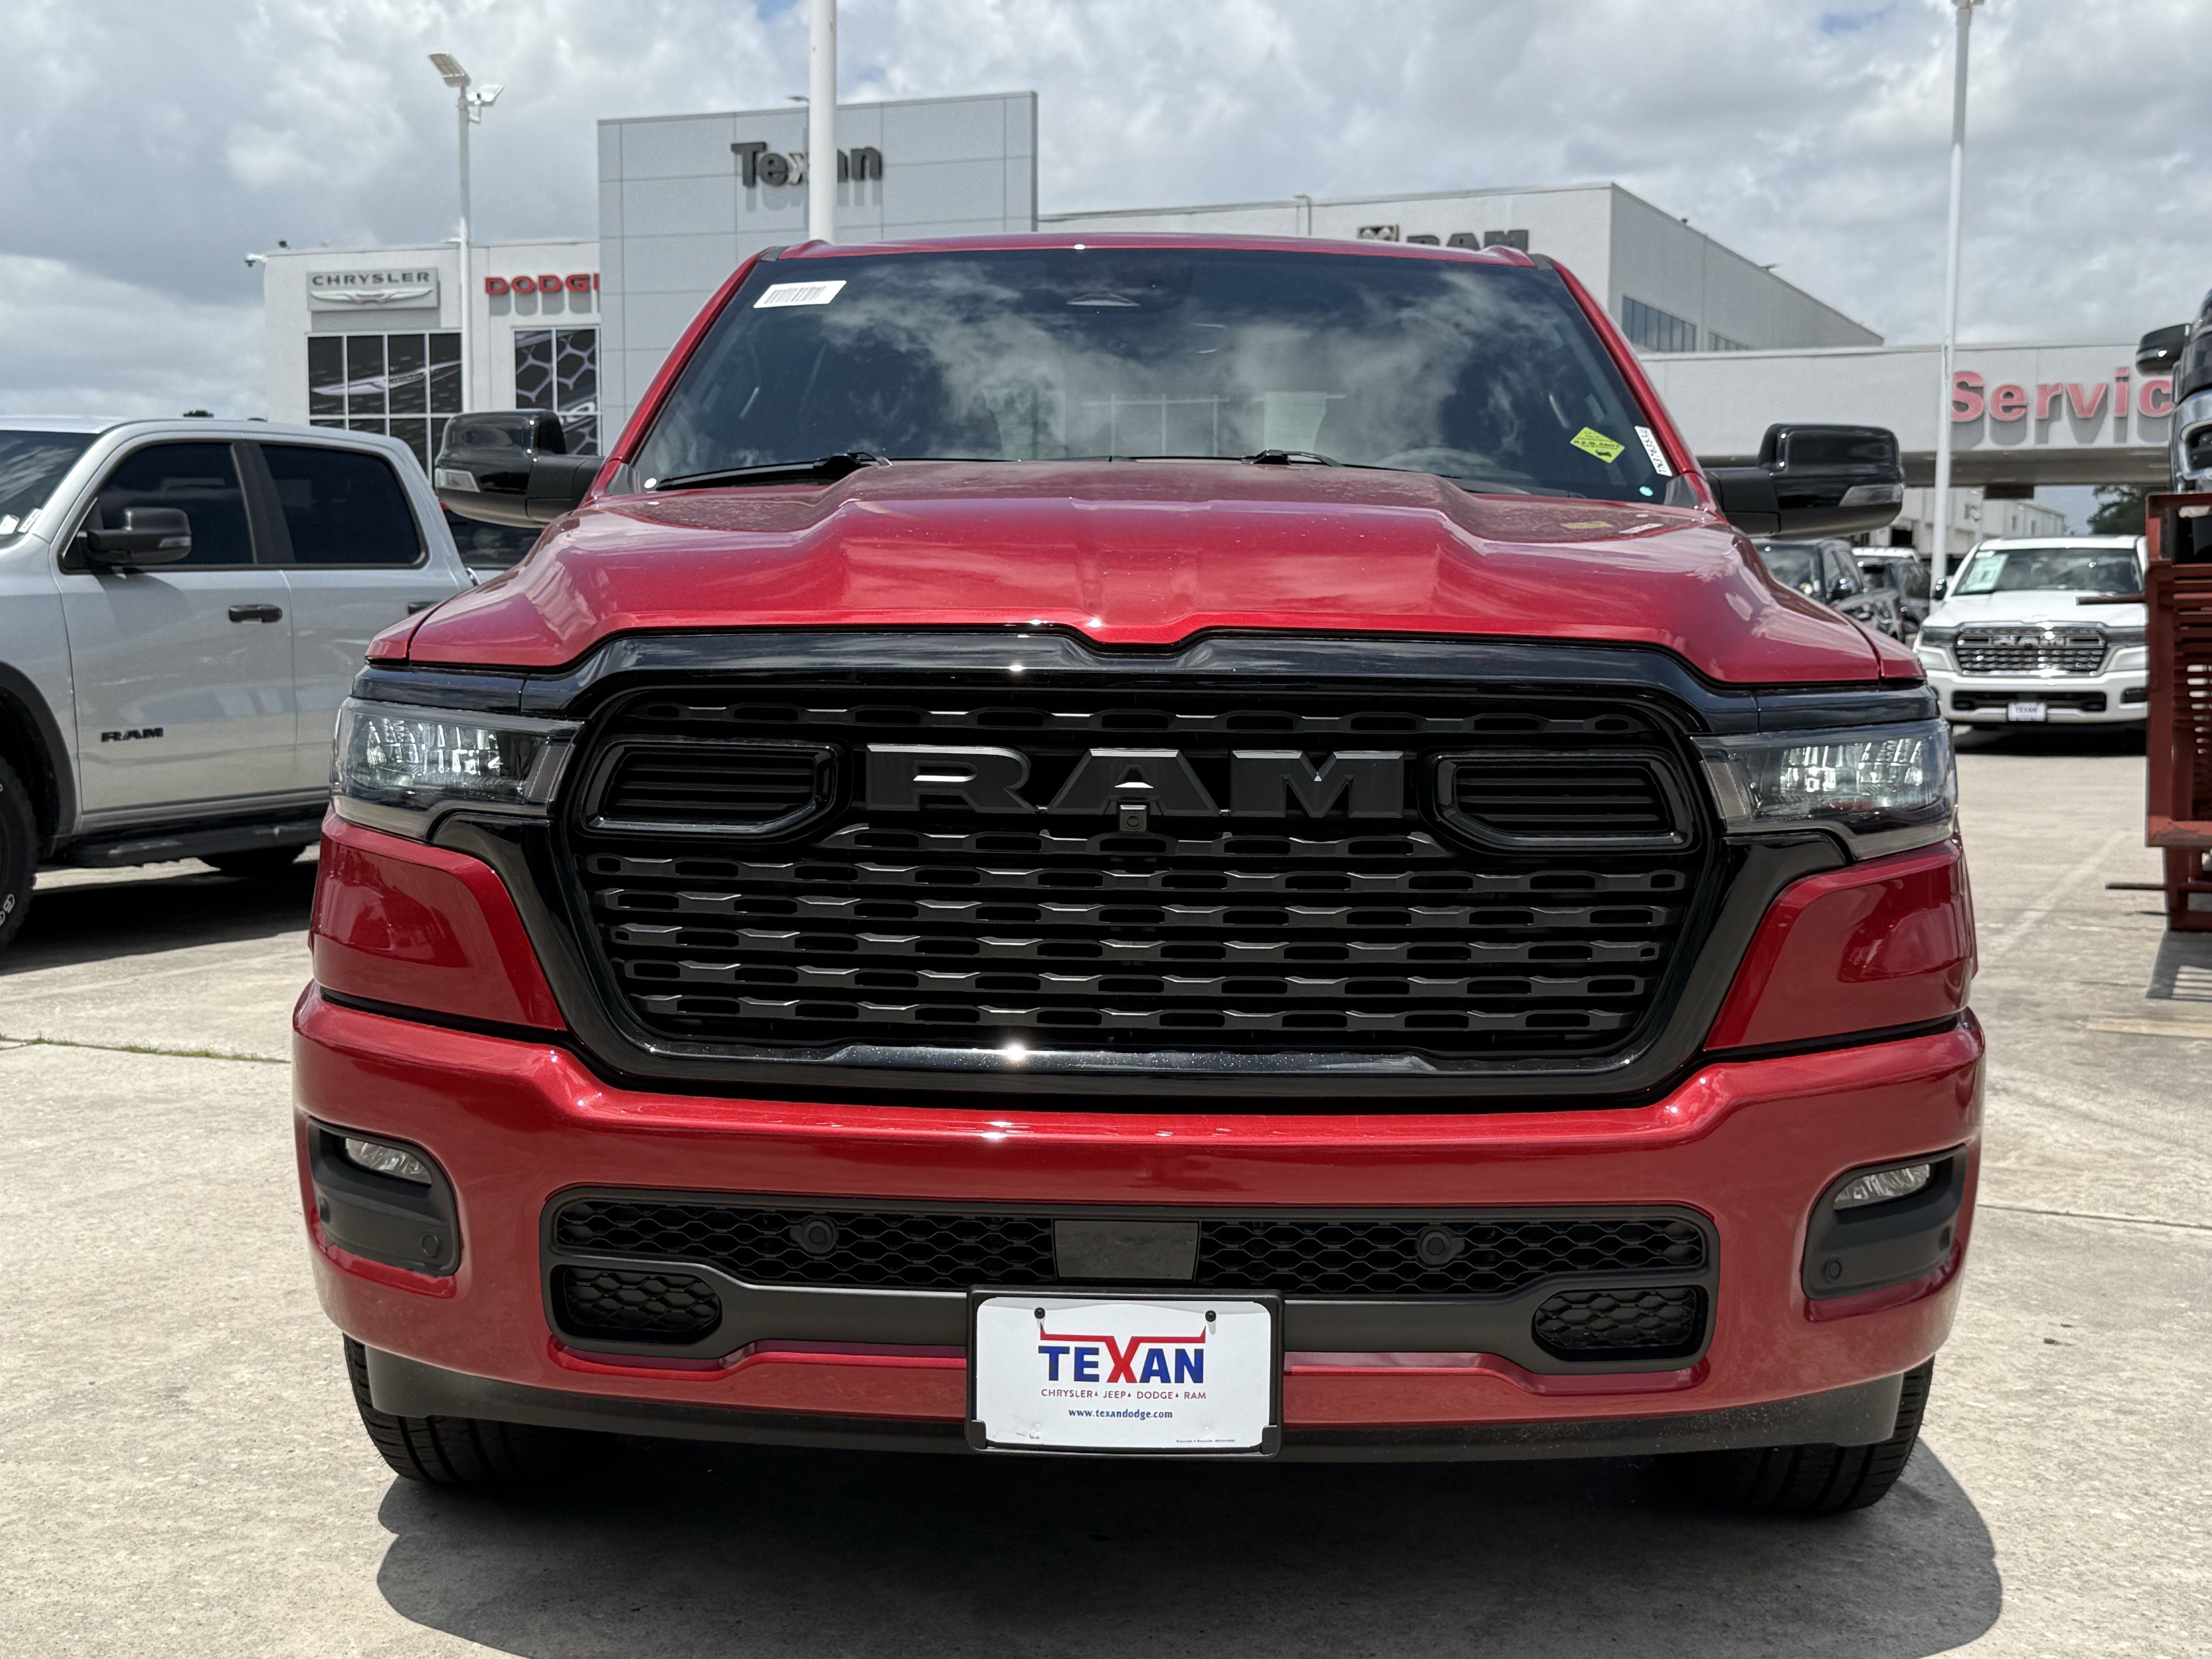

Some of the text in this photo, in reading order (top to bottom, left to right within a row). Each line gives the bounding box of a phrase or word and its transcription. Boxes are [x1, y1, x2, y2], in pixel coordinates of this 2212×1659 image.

[312, 272, 429, 285] CHRYSLER
[486, 273, 600, 294] DODG
[101, 728, 163, 742] RAM
[866, 744, 1403, 818] RAM
[1038, 1332, 1205, 1383] TEXAN
[1041, 1389, 1093, 1398] CHRYSLER
[1137, 1391, 1173, 1399] DODGE
[1184, 1391, 1206, 1400] RAM
[1068, 1409, 1173, 1420] www.texandodge.com
